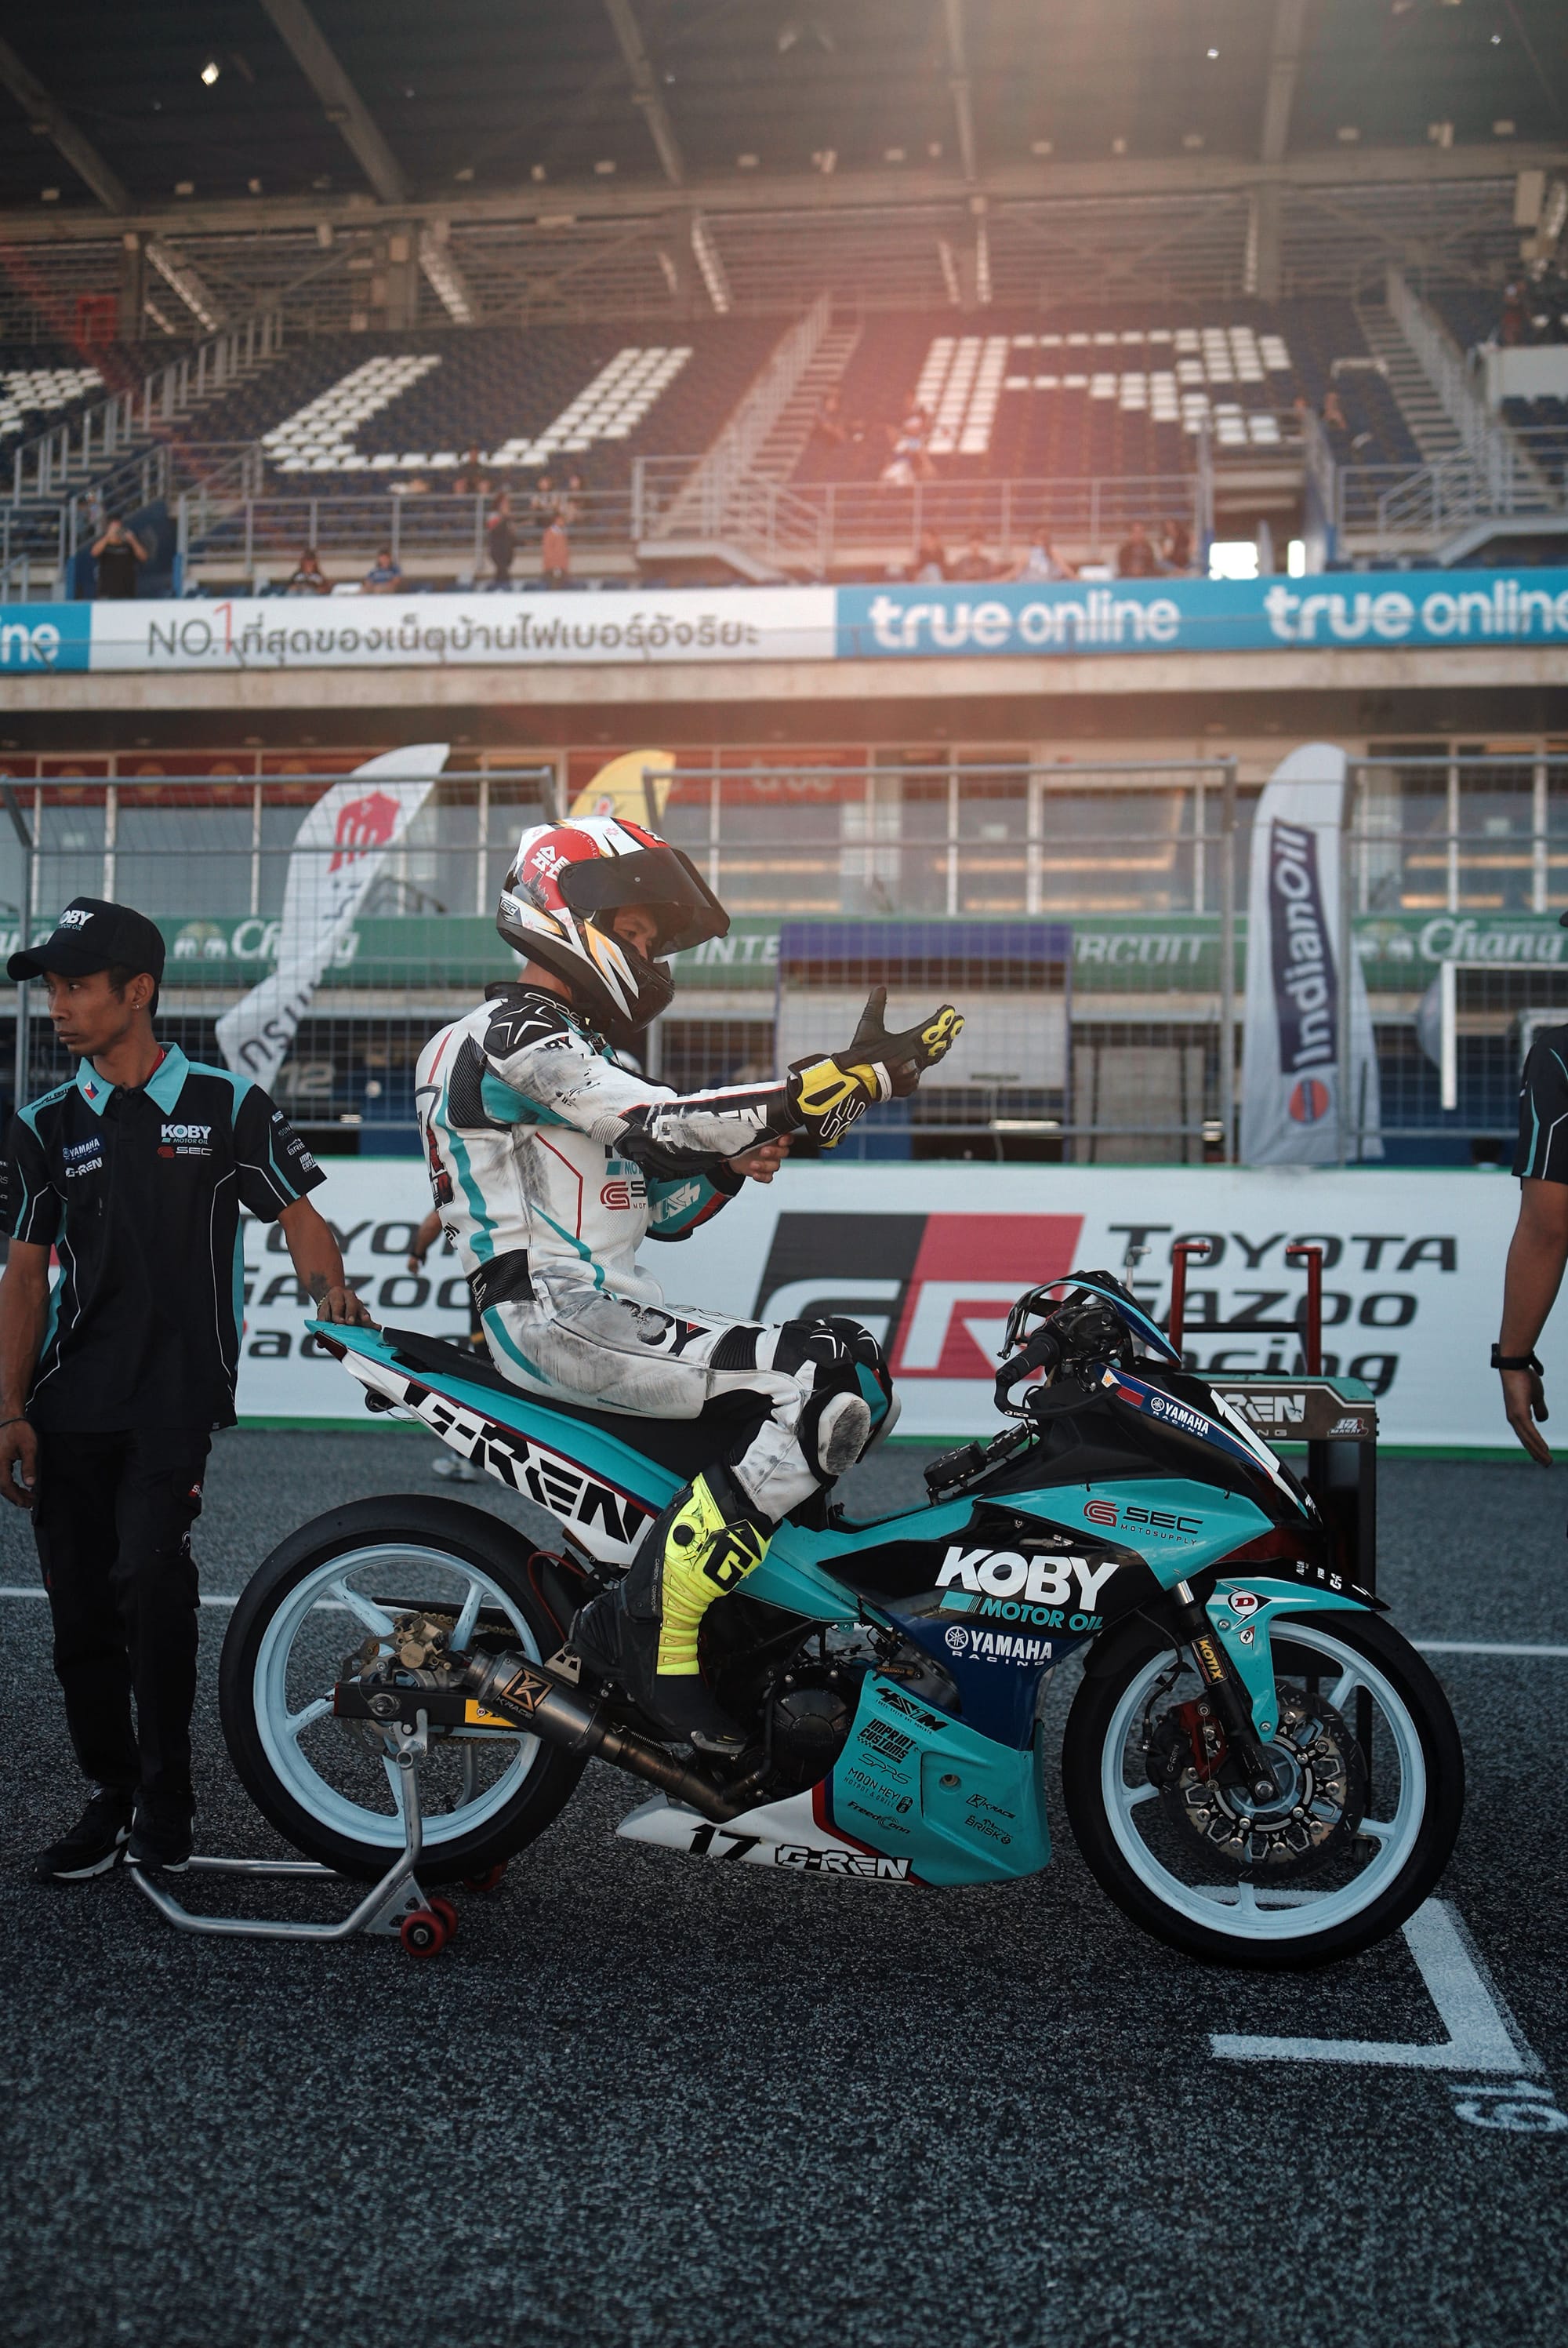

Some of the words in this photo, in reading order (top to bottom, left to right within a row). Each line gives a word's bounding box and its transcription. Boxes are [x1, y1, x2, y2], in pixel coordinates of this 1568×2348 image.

[869, 592, 1011, 649] true
[1018, 591, 1180, 643] online
[1265, 583, 1414, 641] true
[58, 910, 94, 926] OBY
[161, 1123, 212, 1139] KOBY
[70, 1138, 100, 1157] YAMAHA
[176, 1147, 213, 1156] SEC
[65, 1157, 103, 1178] G-REN
[1109, 1226, 1458, 1271] TOYOTA
[1152, 1411, 1203, 1437] RACING
[1165, 1402, 1210, 1434] YAMAHA
[1120, 1524, 1198, 1546] MOTOSUPPLY
[1122, 1507, 1204, 1536] SEC
[935, 1546, 1120, 1612] KOBY
[979, 1597, 1065, 1630] MOTOR
[1069, 1612, 1104, 1631] OIL
[952, 1650, 1046, 1667] RACING
[968, 1629, 1053, 1661] YAMAHA
[858, 1728, 909, 1759] CUSTOMS
[866, 1718, 916, 1750] IMPRINT
[848, 1767, 879, 1789] MOON
[878, 1785, 902, 1802] HEY!
[858, 1753, 913, 1785] SPRS
[690, 1823, 762, 1860] 17
[964, 1816, 1001, 1837] BRISK
[777, 1846, 910, 1880] G-REN
